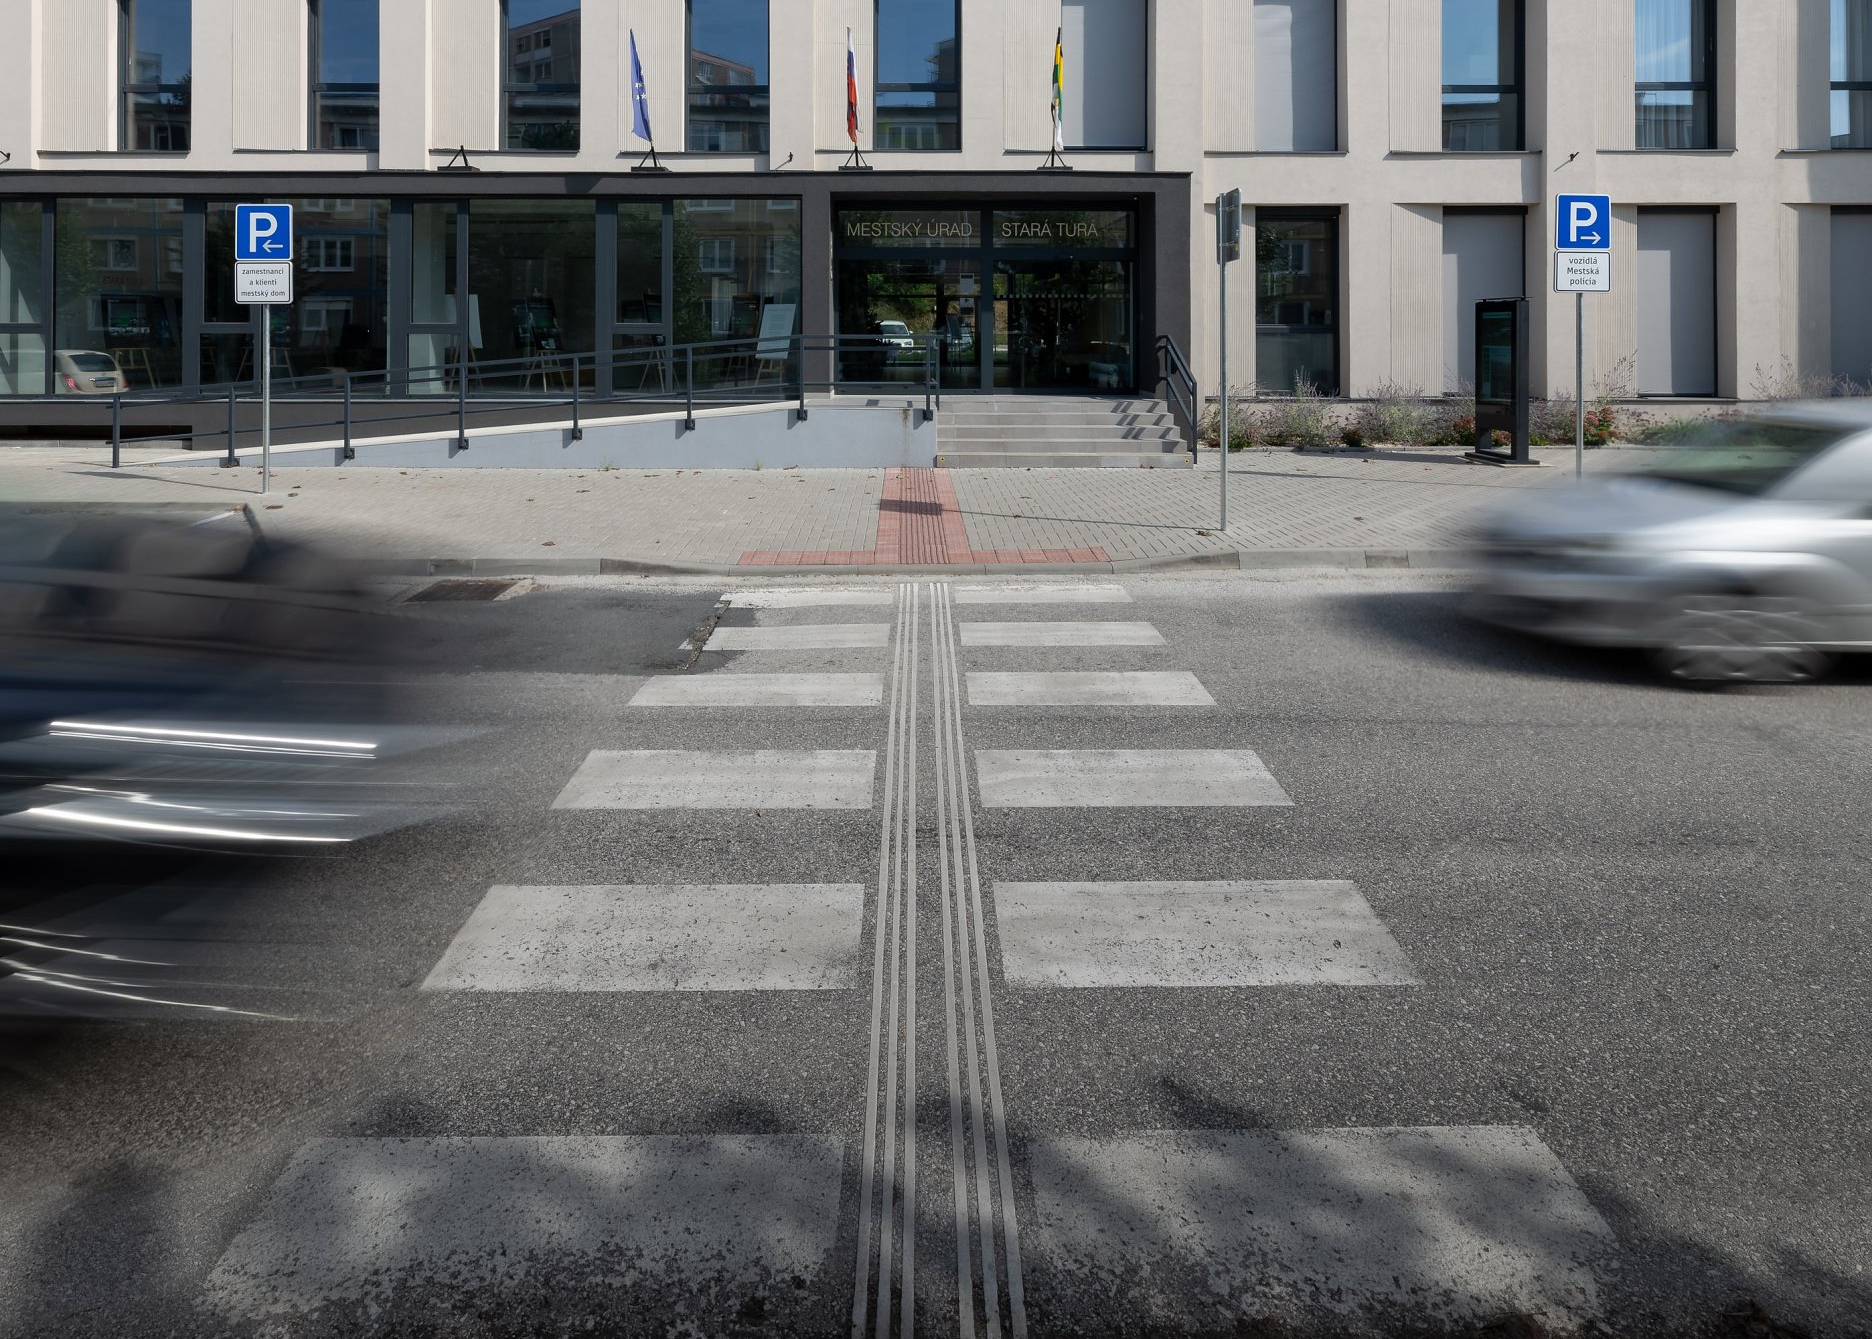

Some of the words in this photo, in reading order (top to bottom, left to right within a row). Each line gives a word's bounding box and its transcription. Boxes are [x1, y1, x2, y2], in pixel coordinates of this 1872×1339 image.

[1570, 201, 1598, 242] P
[847, 218, 922, 237] MESTSKÝ
[927, 218, 972, 237] ÚRAD
[1001, 219, 1052, 237] STARÁ
[249, 212, 278, 253] P
[1568, 257, 1598, 265] vozidlá
[1567, 267, 1599, 275] Mestská
[256, 278, 277, 286] klienti
[241, 289, 268, 298] mestský
[271, 289, 285, 297] dom
